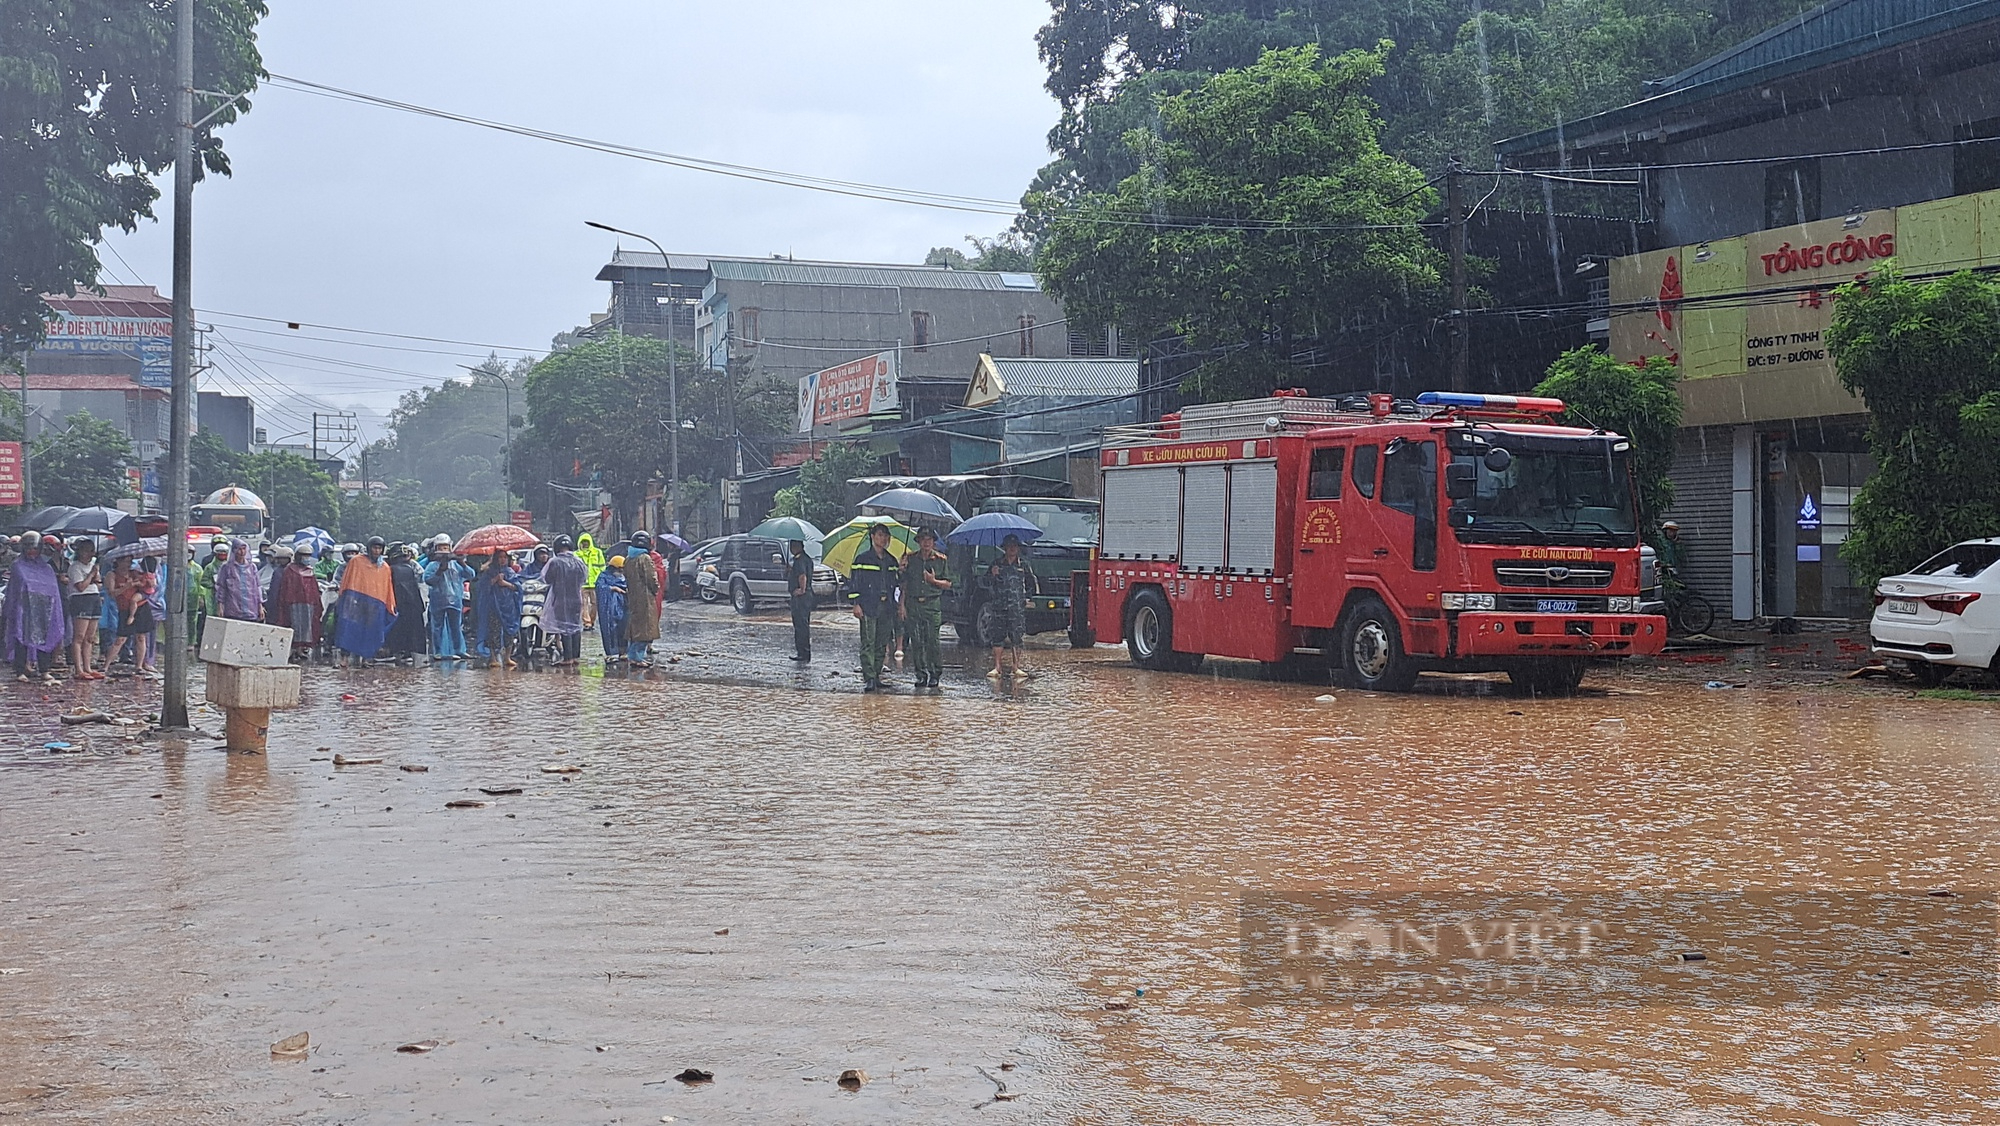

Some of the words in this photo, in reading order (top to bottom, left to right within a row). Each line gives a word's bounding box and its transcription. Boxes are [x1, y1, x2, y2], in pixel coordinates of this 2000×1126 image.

[1761, 242, 1823, 276] TỔNG
[1826, 234, 1893, 265] CÔNG
[111, 321, 134, 336] NAM
[38, 341, 75, 350] NAM
[1747, 337, 1773, 349] CÔNG
[1775, 335, 1788, 346] TY
[1790, 331, 1819, 344] TNHH
[1747, 355, 1766, 367] Đ/C:
[1767, 354, 1781, 365] 197
[1788, 348, 1824, 363] ĐƯỜNG
[1143, 450, 1154, 461] XE
[1156, 447, 1172, 460] CỨU
[1175, 448, 1193, 461] NẠN
[1196, 444, 1213, 458] CỨU
[1215, 443, 1228, 459] HỘ
[1520, 548, 1530, 559] XE
[1533, 548, 1548, 559] CỨU
[1550, 549, 1565, 560] NẠN
[1568, 549, 1582, 560] CỨU
[1583, 549, 1593, 560] HỘ
